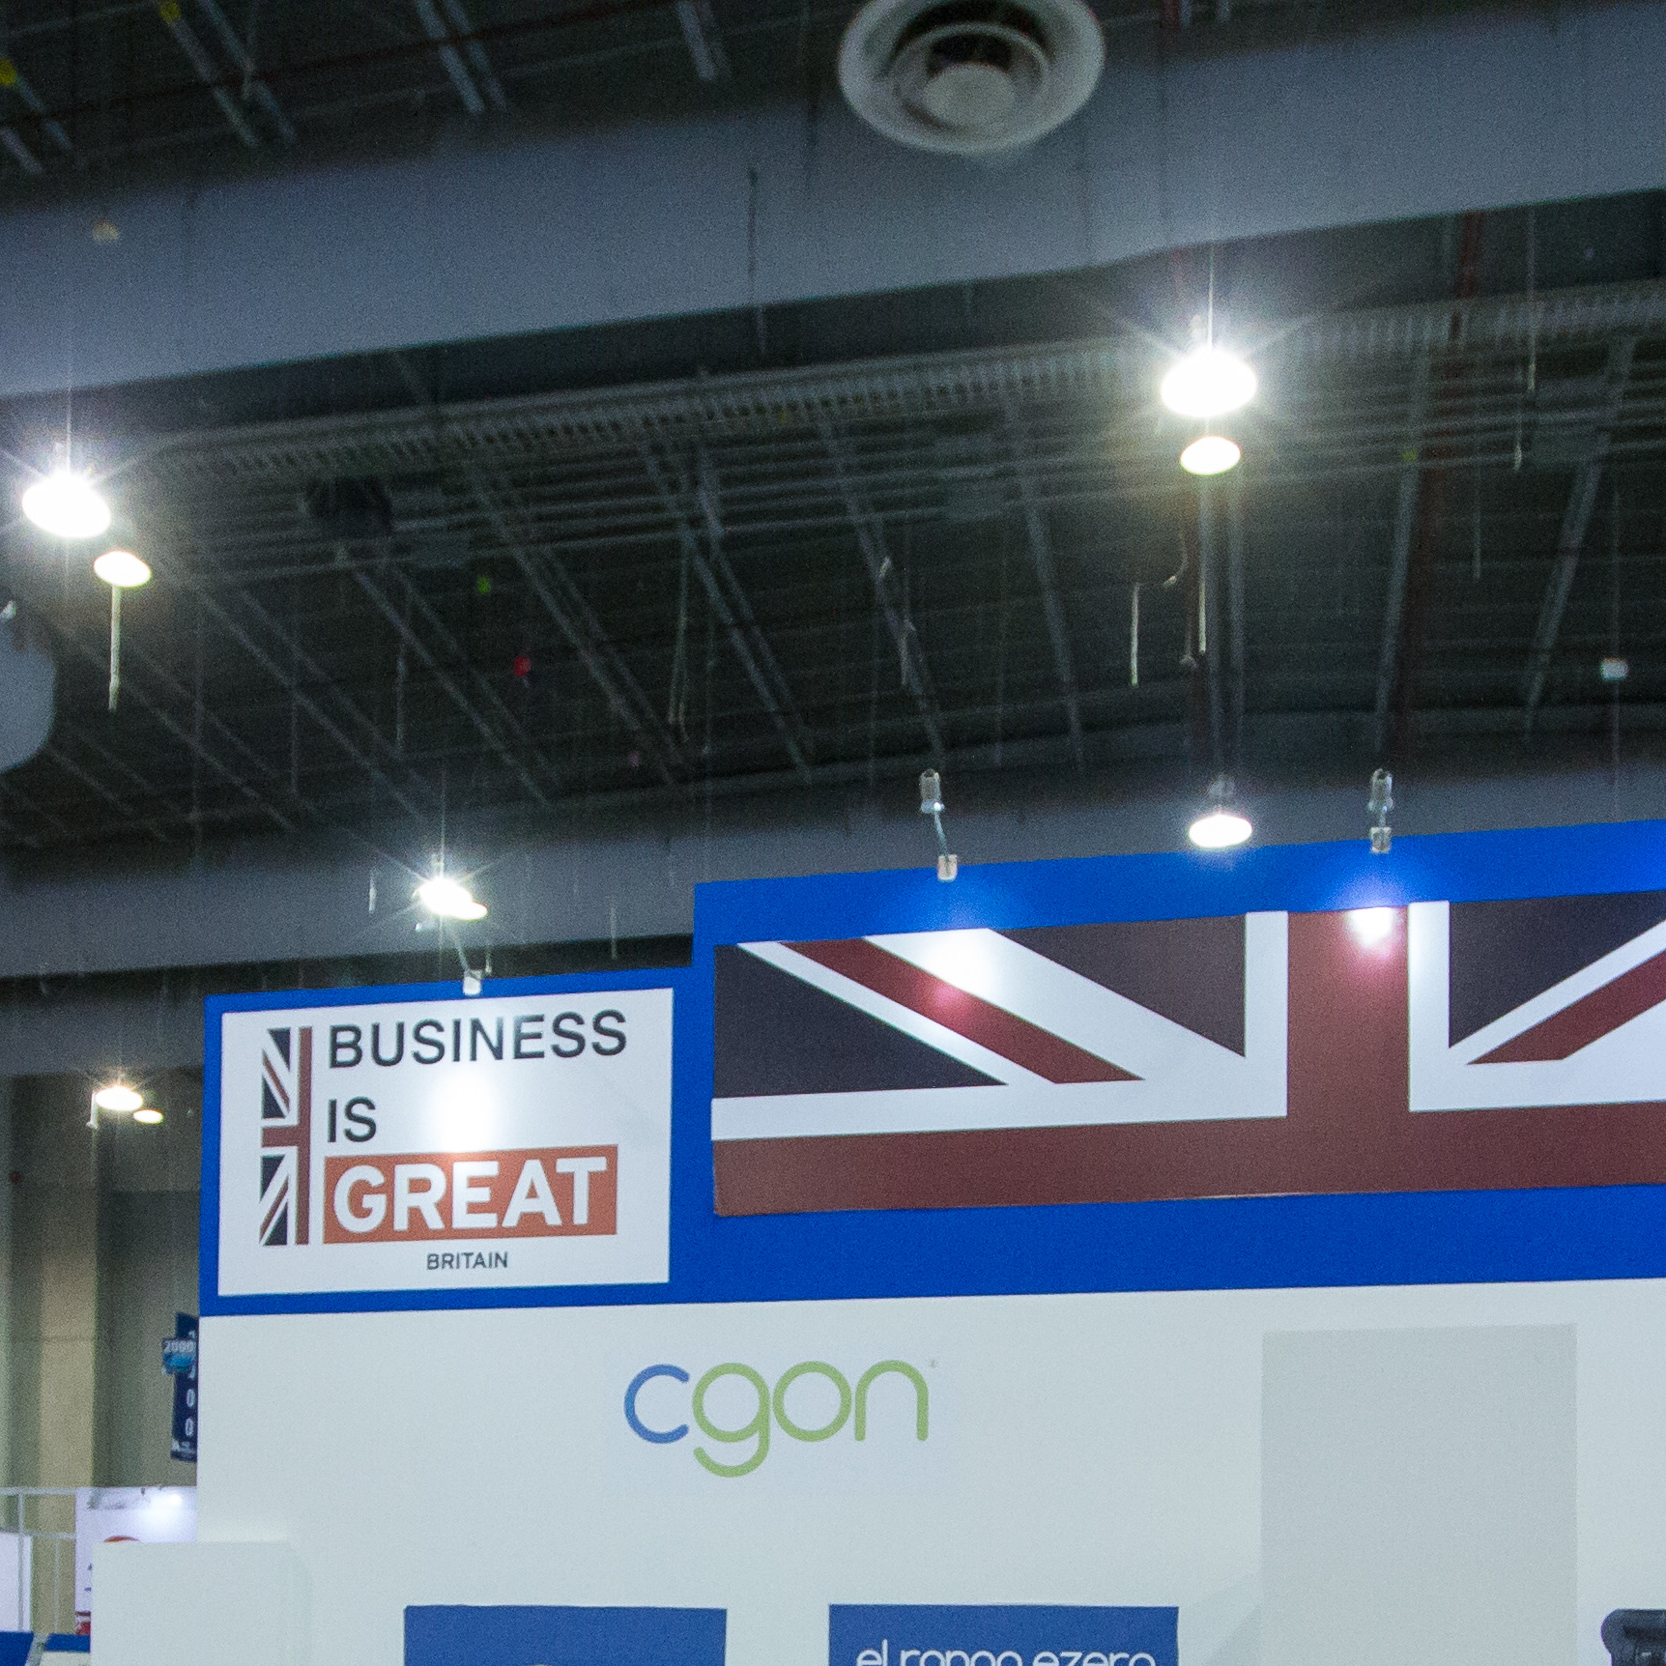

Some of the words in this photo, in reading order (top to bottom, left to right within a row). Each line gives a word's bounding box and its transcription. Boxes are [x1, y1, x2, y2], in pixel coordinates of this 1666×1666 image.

[329, 1009, 628, 1068] BUSINESS
[328, 1096, 377, 1143] IS
[333, 1156, 608, 1234] GREAT
[426, 1251, 509, 1271] BRITAIN
[624, 1360, 928, 1478] cgon
